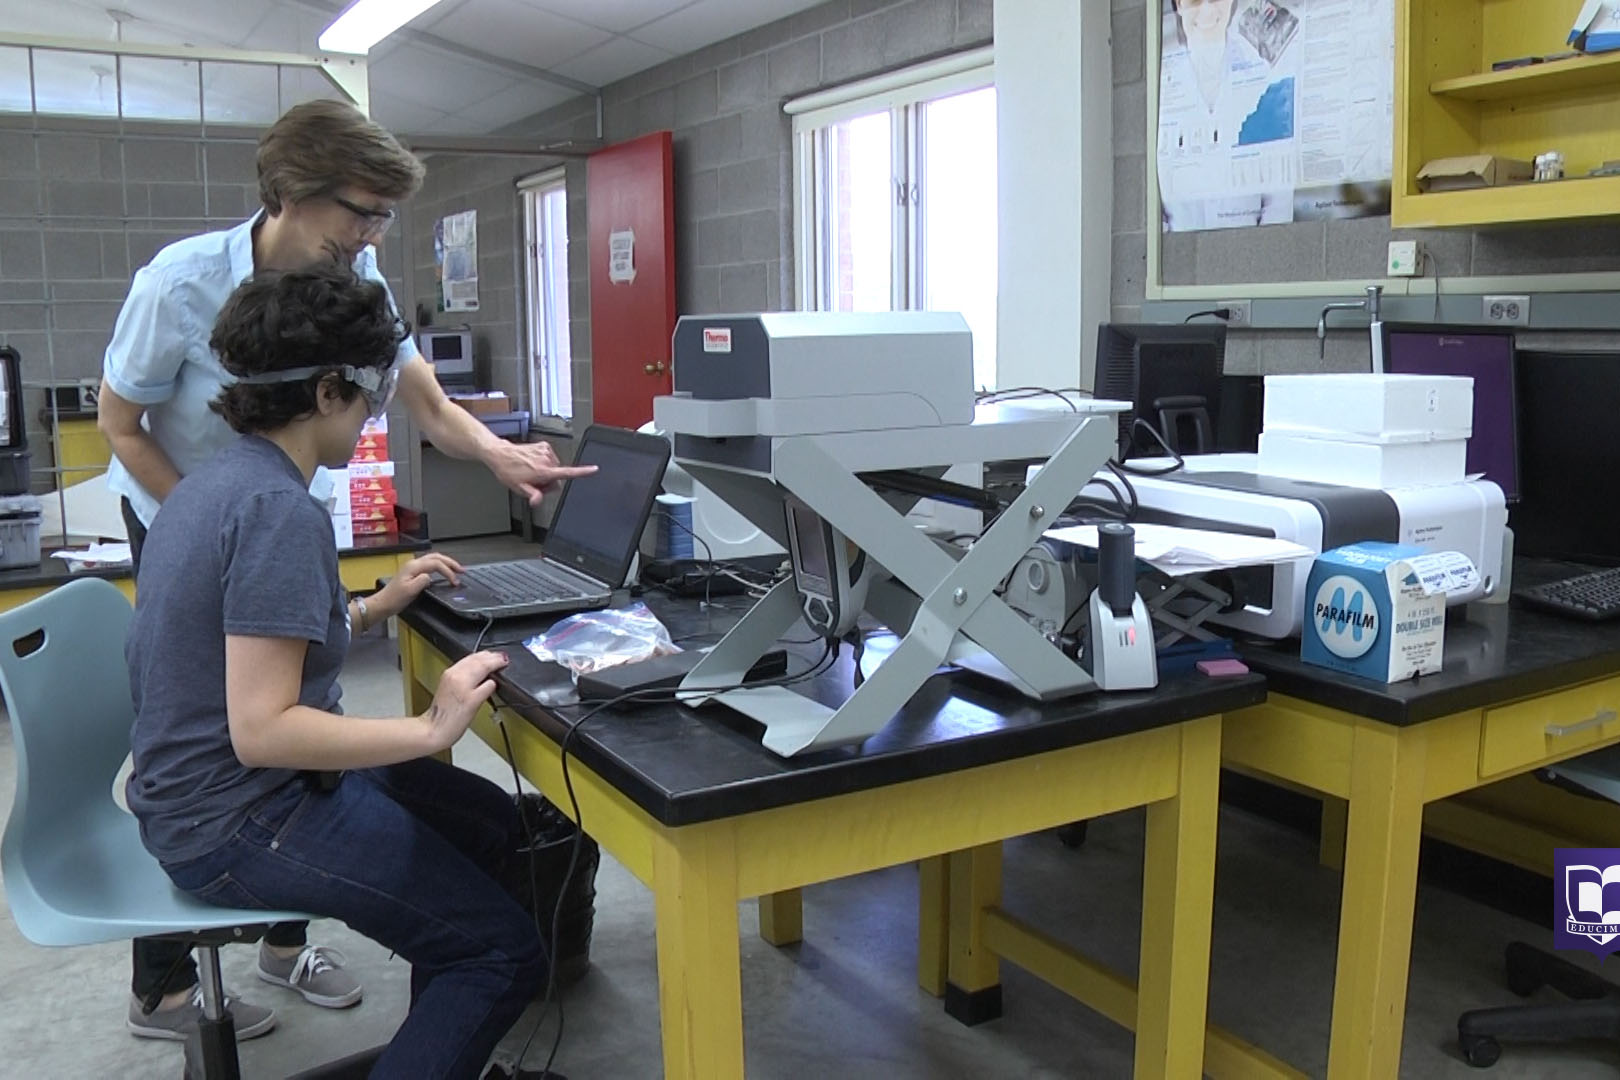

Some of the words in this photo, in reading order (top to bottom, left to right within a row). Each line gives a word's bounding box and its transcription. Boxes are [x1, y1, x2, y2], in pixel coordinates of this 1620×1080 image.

[705, 331, 728, 342] Thermo
[1316, 603, 1374, 630] PARAFILM
[1396, 620, 1418, 634] DOUBLE
